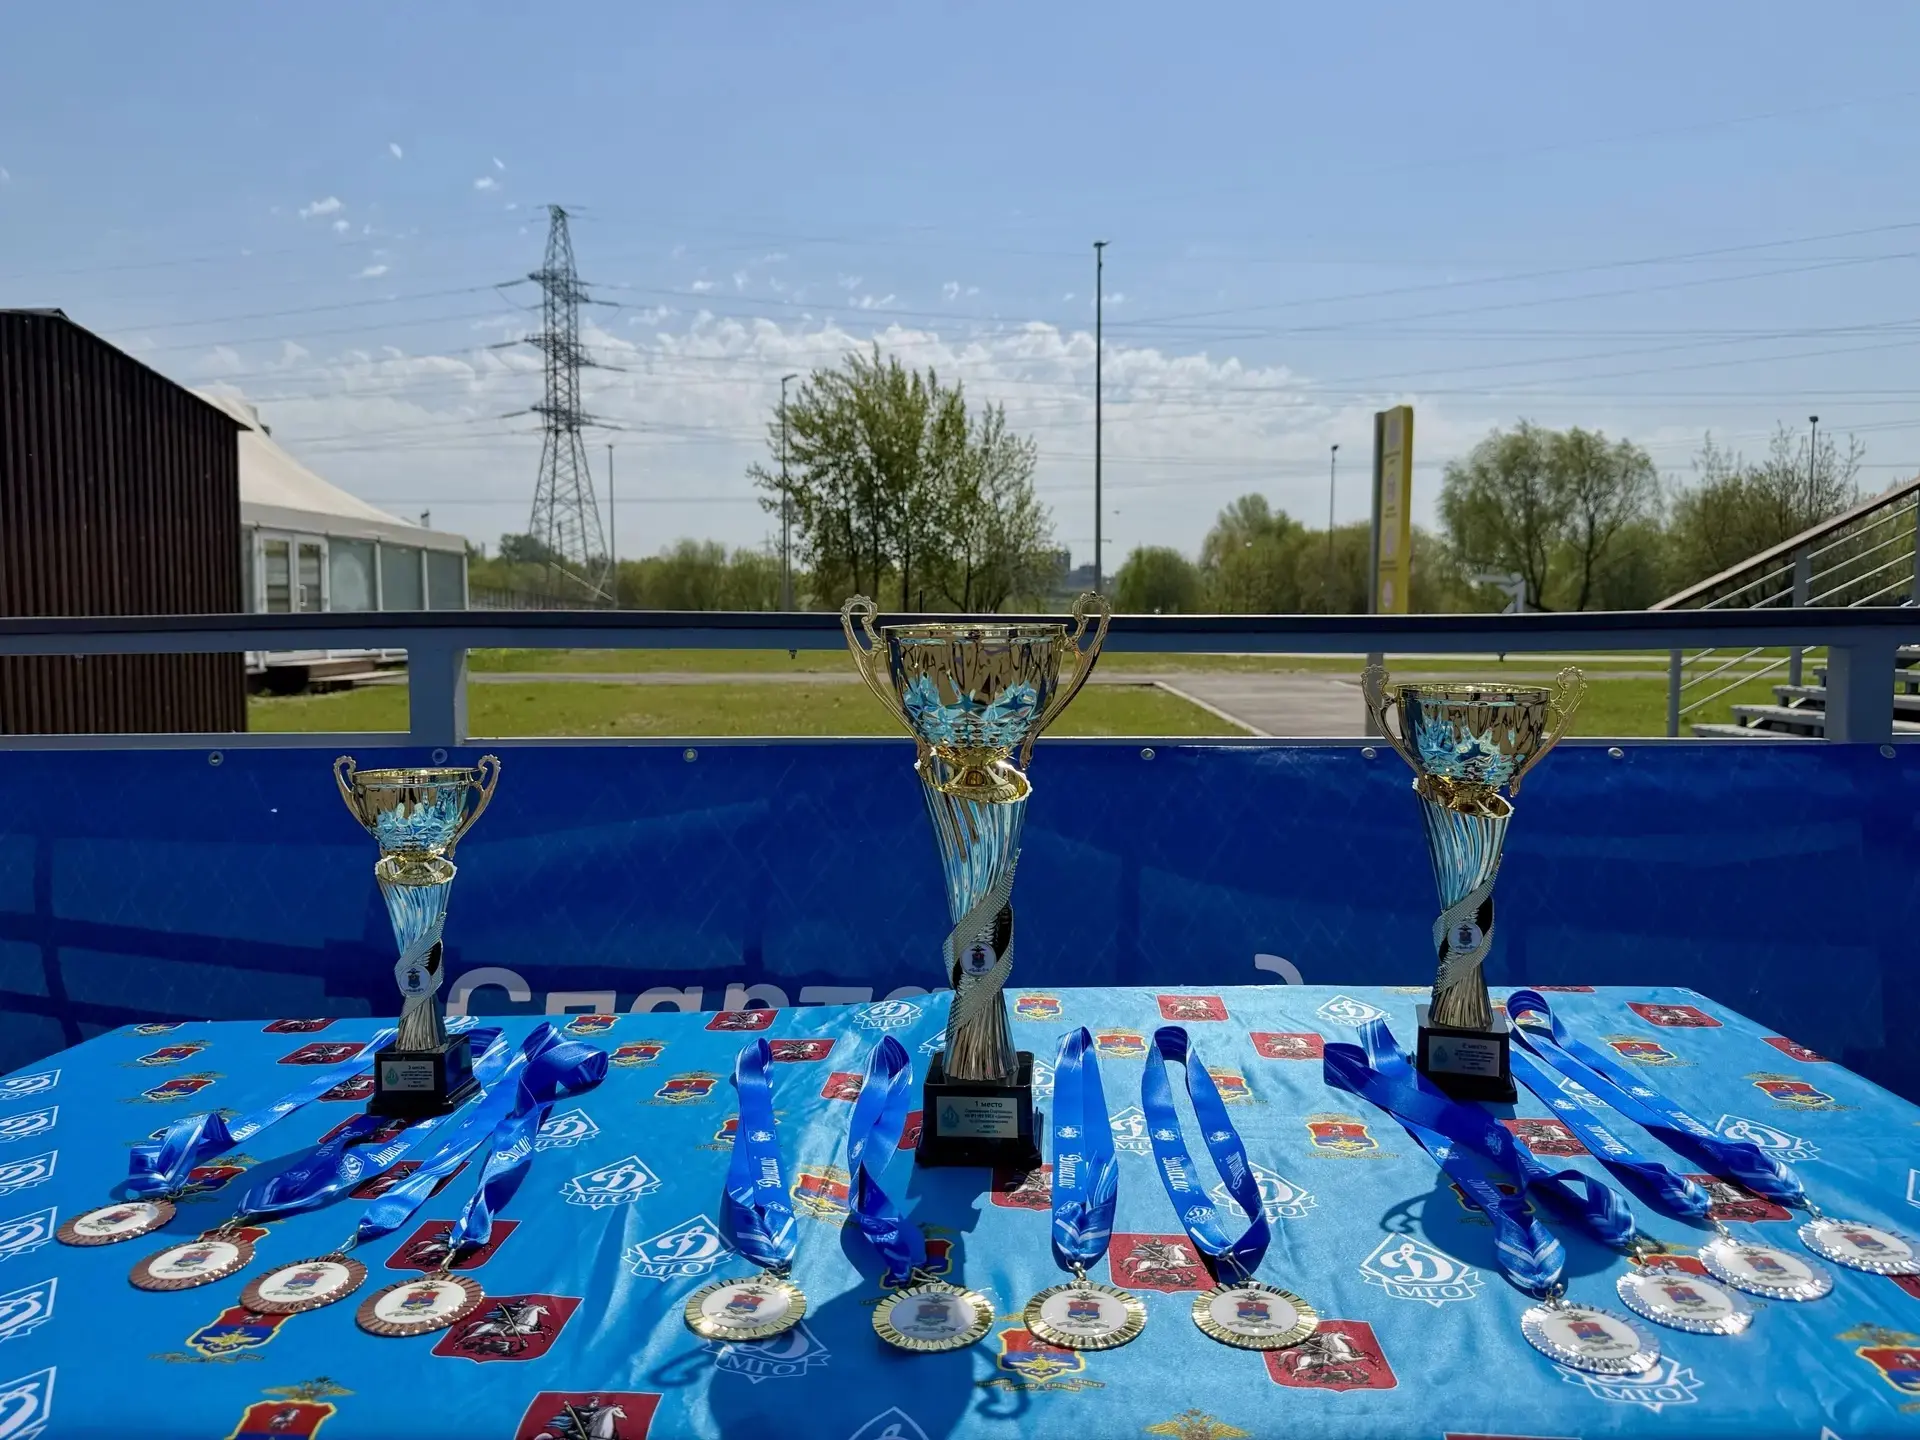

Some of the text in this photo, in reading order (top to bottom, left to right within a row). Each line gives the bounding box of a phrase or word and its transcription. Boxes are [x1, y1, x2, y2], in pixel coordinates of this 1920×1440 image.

[867, 1018, 906, 1027] МГО
[575, 1193, 628, 1206] МГО
[642, 1262, 704, 1277] МГО
[1394, 1284, 1464, 1298] МГО
[725, 1355, 798, 1376] МГО
[1602, 1387, 1681, 1401] МГО
